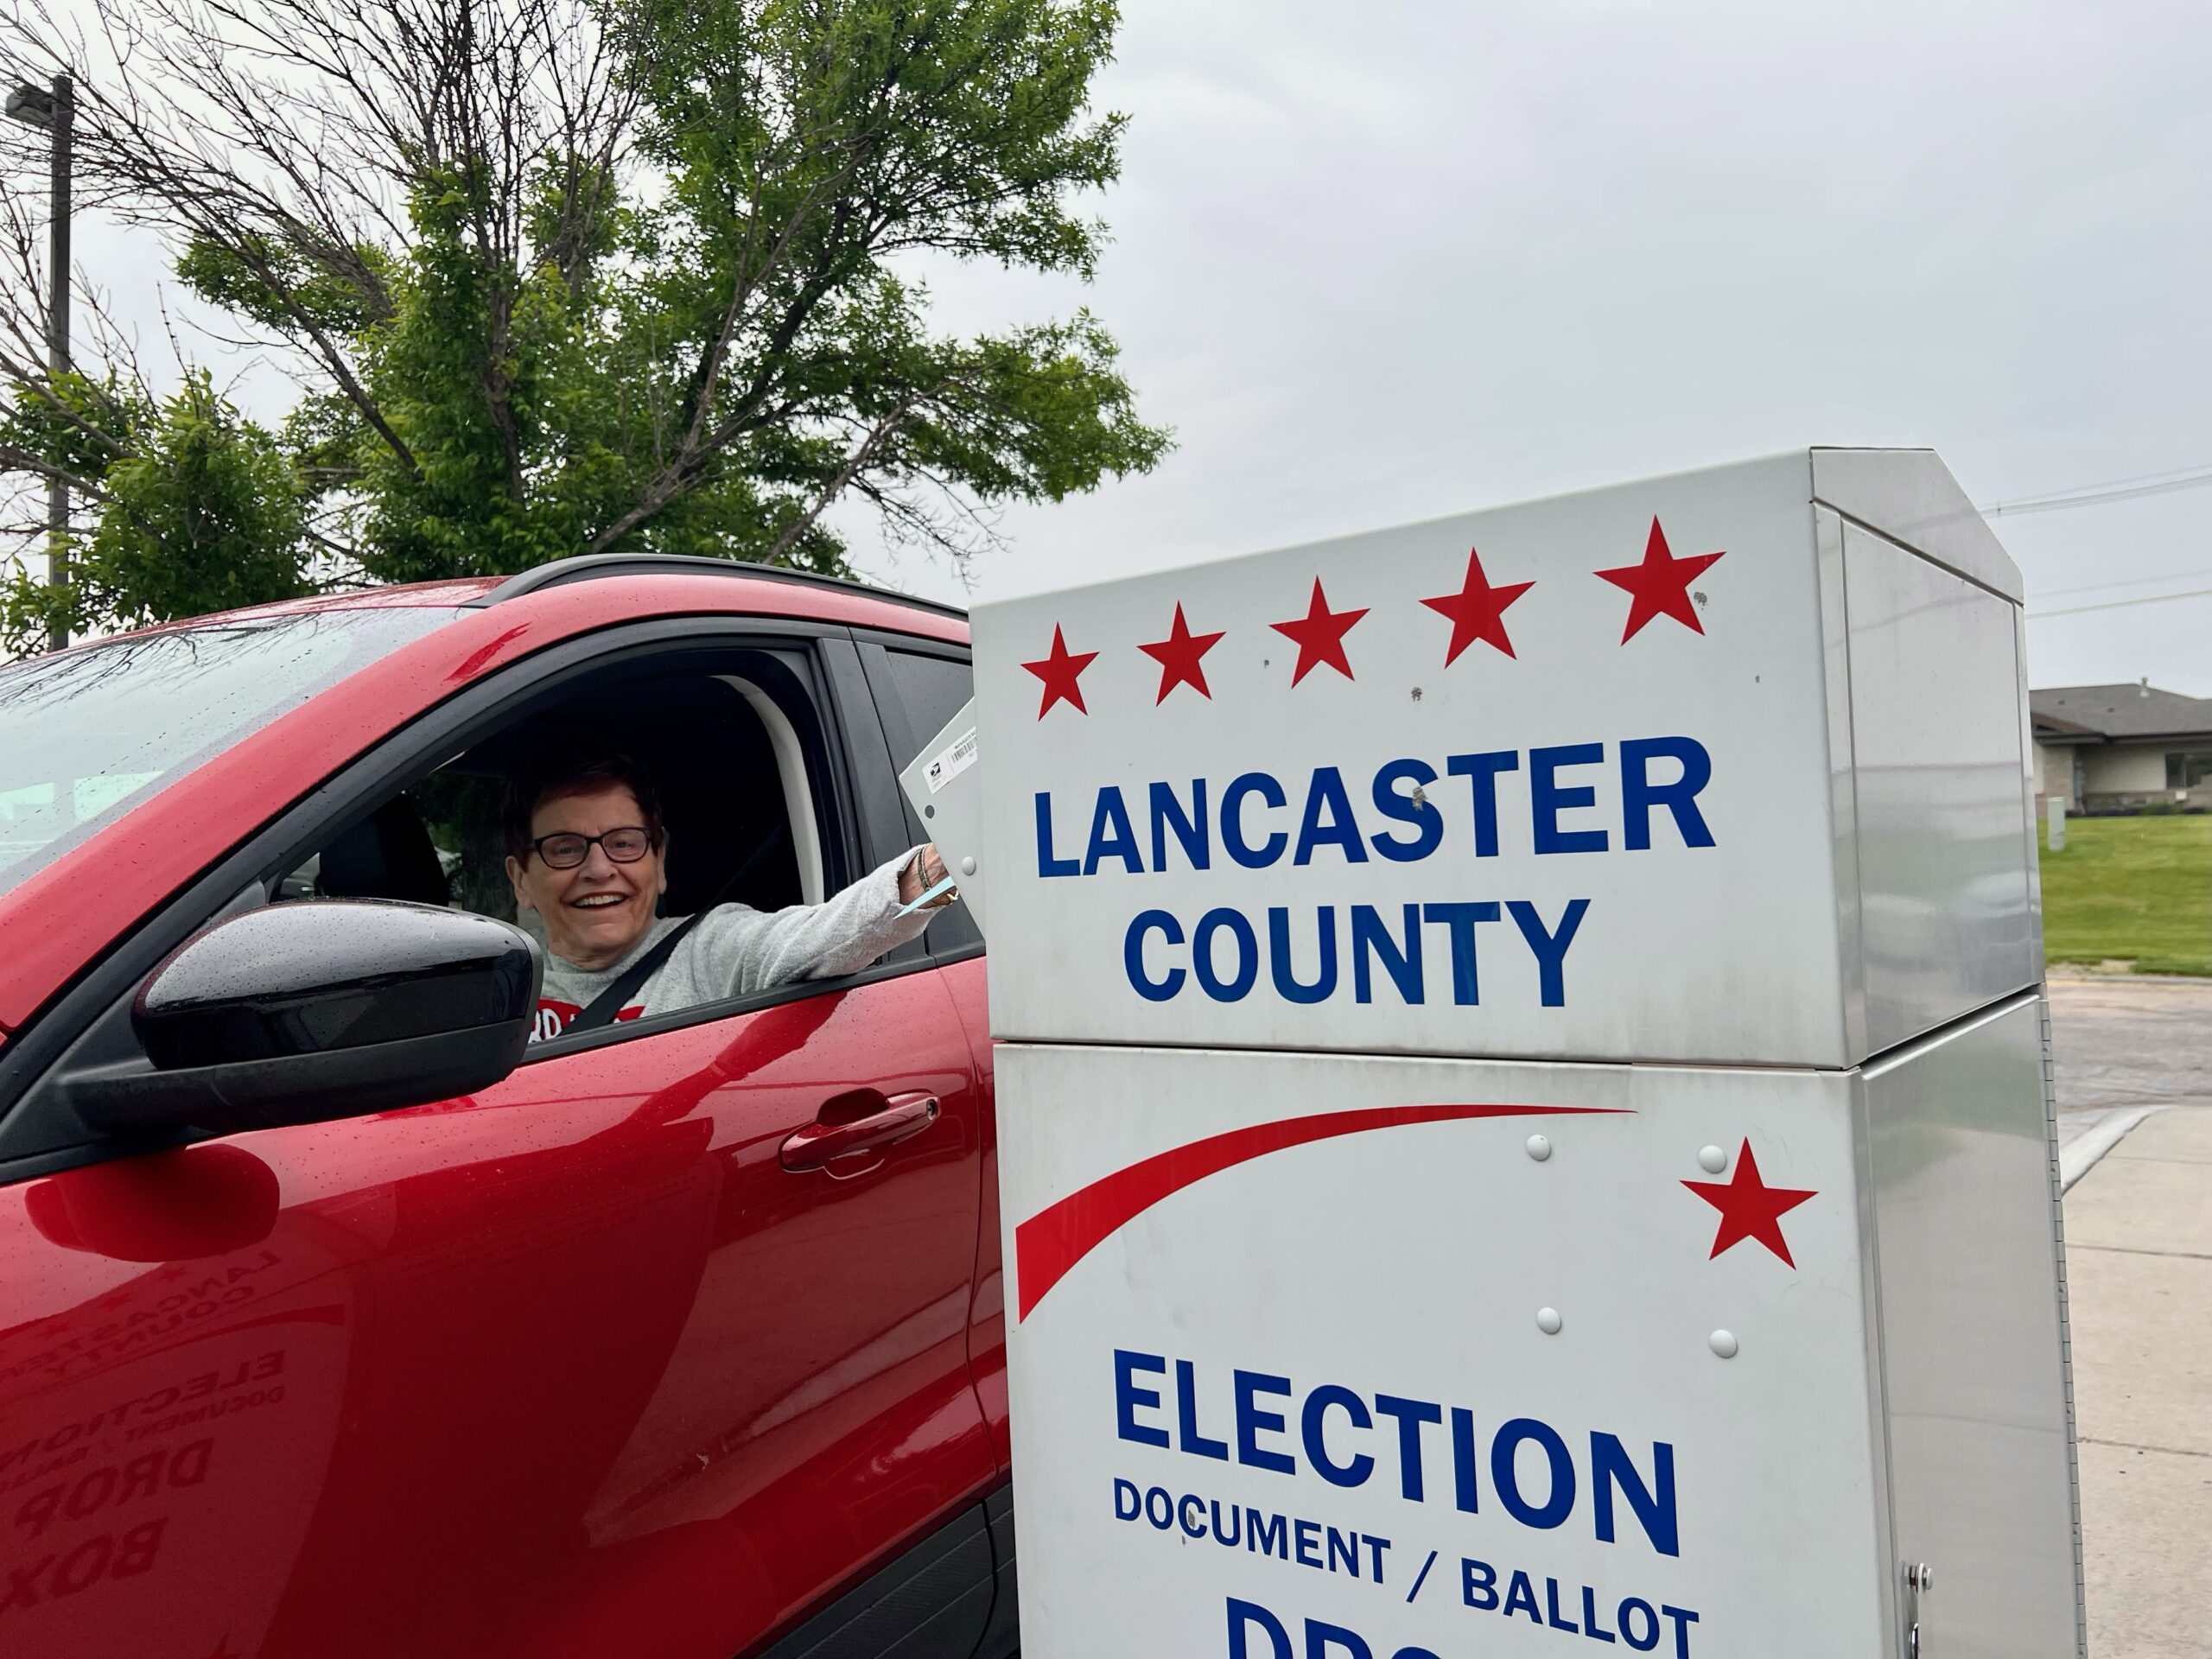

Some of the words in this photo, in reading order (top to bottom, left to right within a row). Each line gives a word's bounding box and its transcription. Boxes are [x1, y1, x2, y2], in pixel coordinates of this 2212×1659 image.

[1034, 736, 1715, 878] LANCASTER
[1124, 899, 1590, 1007] COUNTY
[1114, 1349, 1679, 1557] ELECTION
[1114, 1478, 1390, 1584] DOCUMENT
[1460, 1558, 1699, 1659] BALLOT
